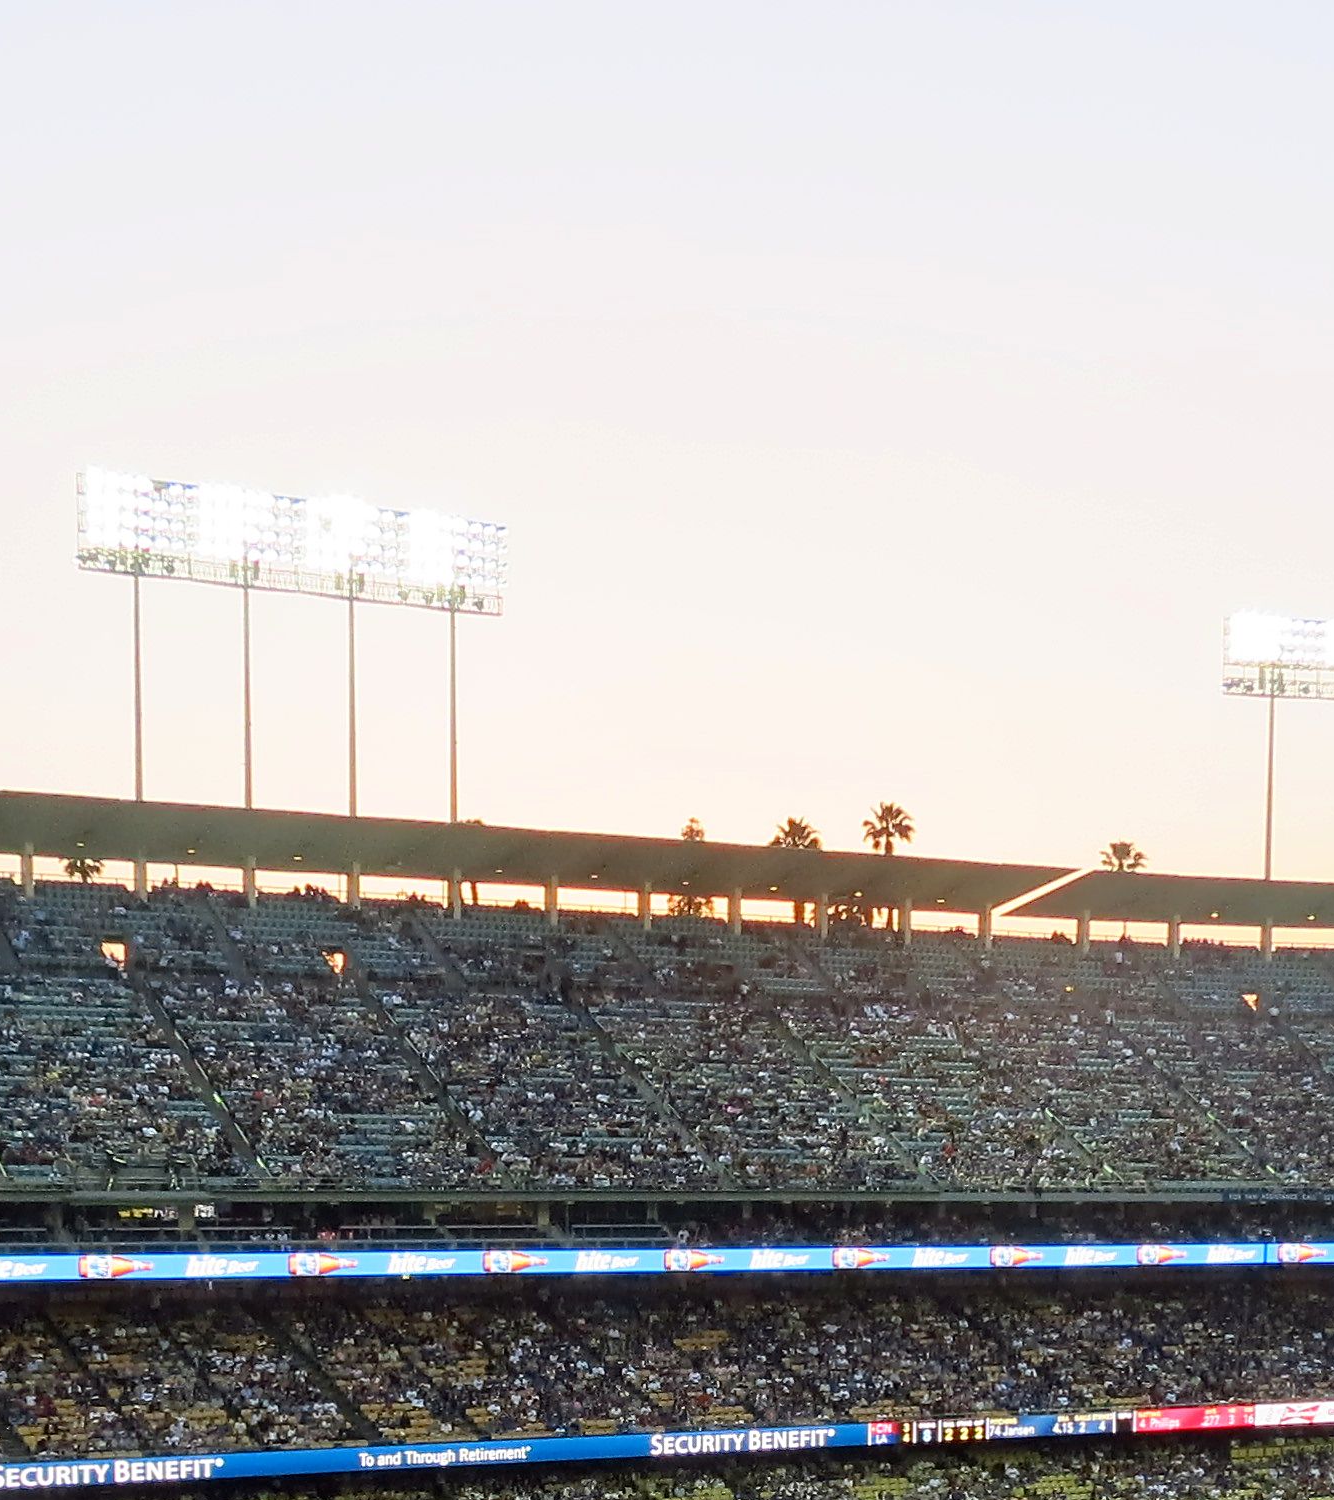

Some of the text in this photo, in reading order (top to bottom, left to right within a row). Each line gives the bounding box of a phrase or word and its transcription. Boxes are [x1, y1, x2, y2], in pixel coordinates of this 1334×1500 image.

[186, 1254, 226, 1276] hite
[387, 1252, 425, 1274] hite
[574, 1249, 612, 1271] hite
[749, 1249, 783, 1270] hite
[989, 1422, 1107, 1437] 74 Jansen 4.15 2 4
[1150, 1417, 1180, 1429] Phillips
[1243, 1414, 1254, 1424] 16
[875, 1434, 888, 1444] LA
[922, 1429, 932, 1442] 8
[944, 1426, 983, 1441] 2 2 2
[650, 1433, 746, 1456] SECURITY
[359, 1453, 375, 1467] To
[377, 1450, 402, 1467] and
[405, 1448, 455, 1466] Through
